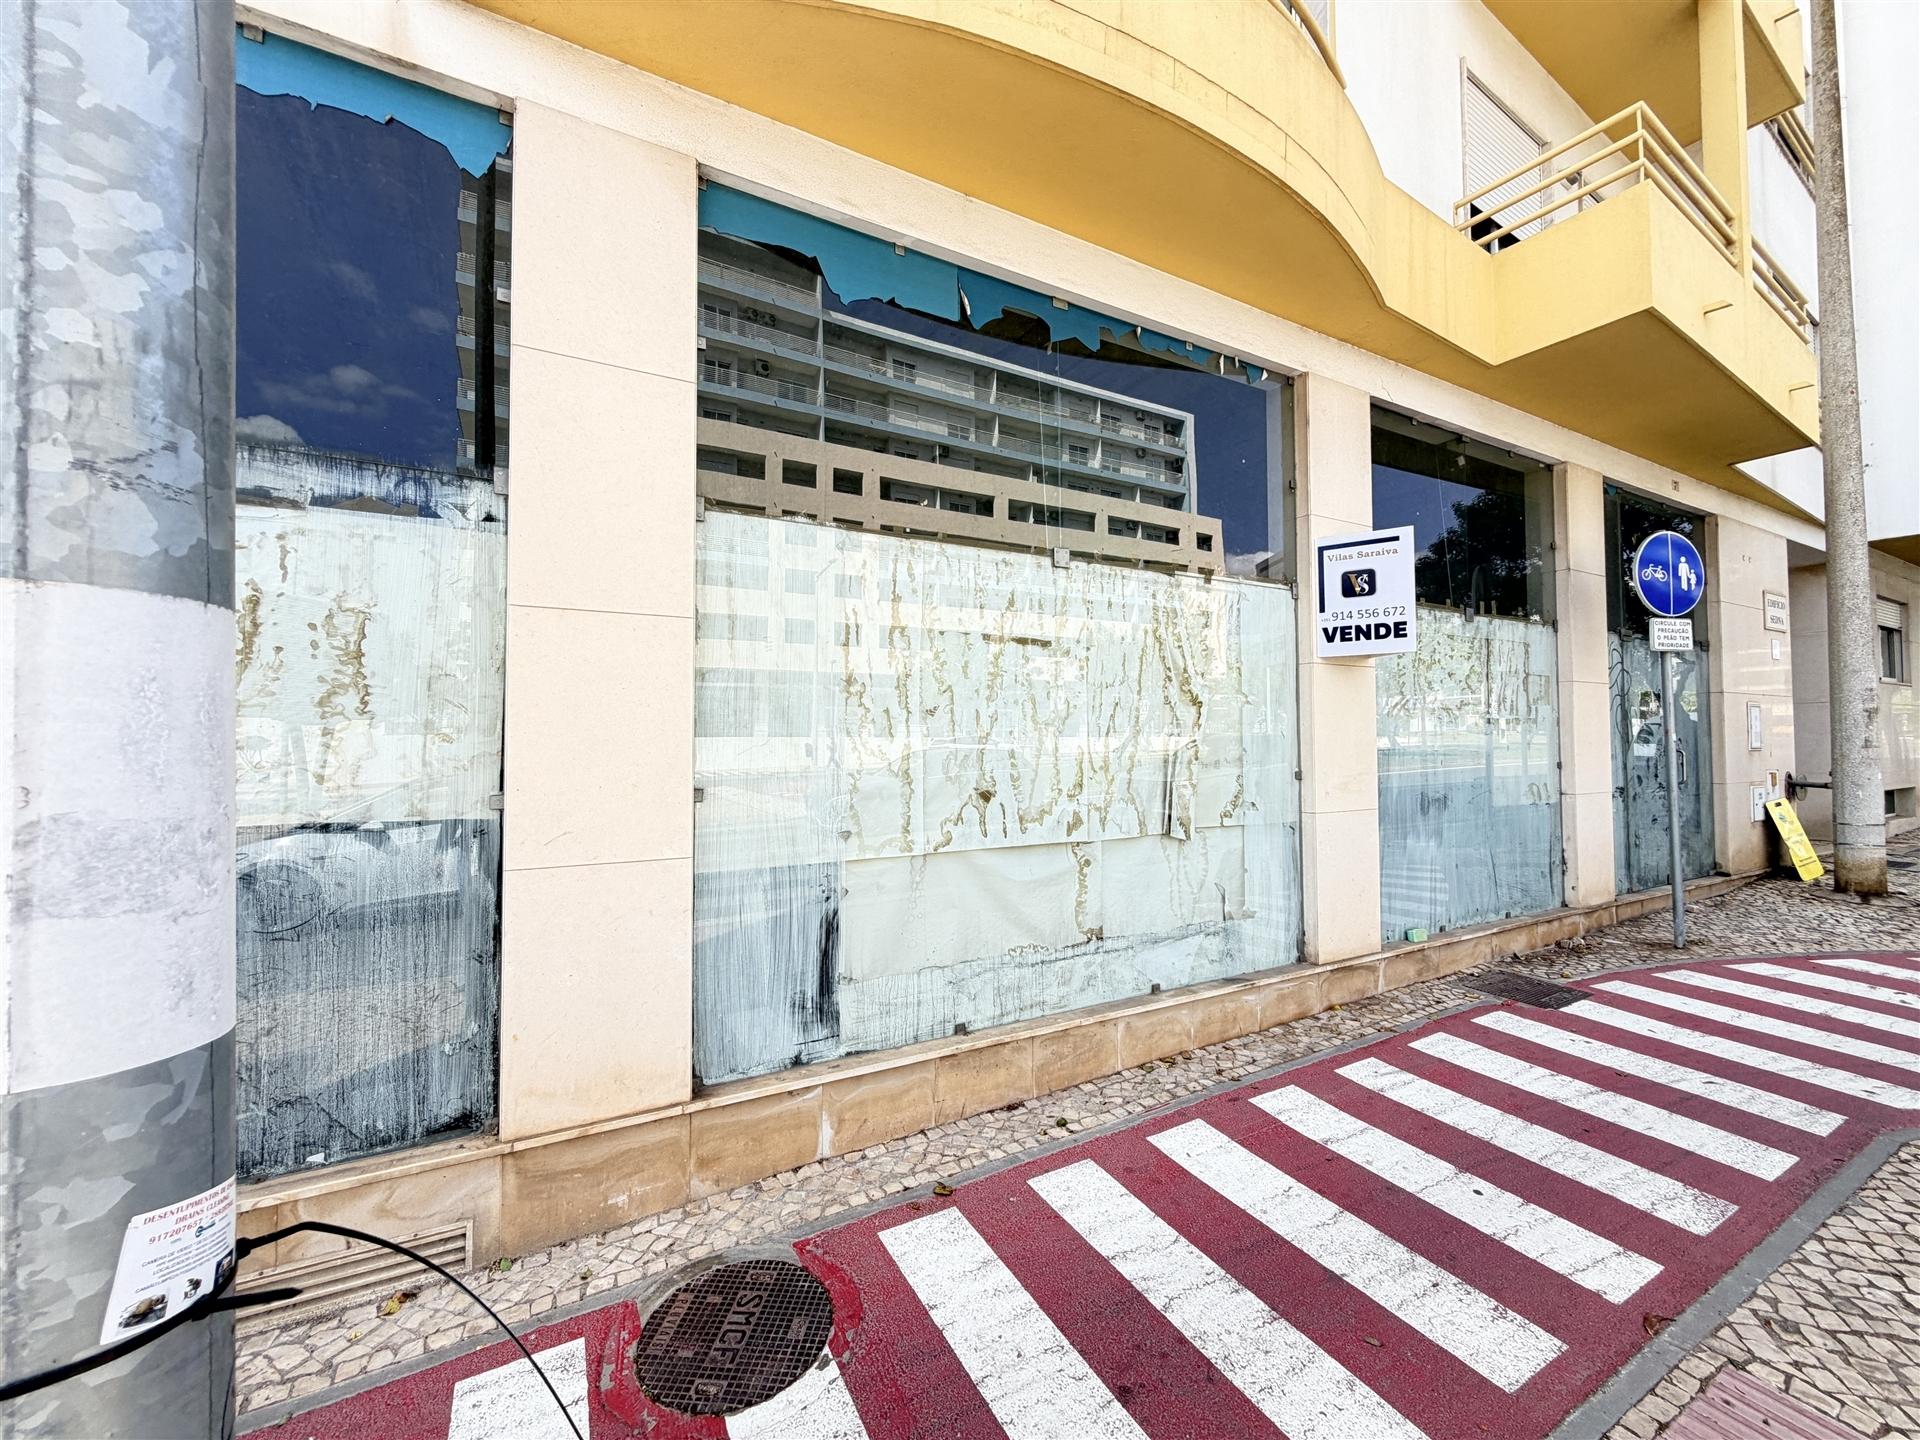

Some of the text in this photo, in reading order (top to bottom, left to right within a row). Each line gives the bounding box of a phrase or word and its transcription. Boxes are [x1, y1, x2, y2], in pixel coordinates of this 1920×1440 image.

[1327, 547, 1399, 563] Vilas Saraiva
[1347, 573, 1370, 595] VS
[1331, 610, 1353, 622] 914
[1357, 608, 1380, 619] 556
[1383, 605, 1406, 617] 672
[1322, 620, 1408, 643] VENDE
[174, 1208, 205, 1225] DRAINS
[148, 1218, 203, 1245] 917207657
[711, 1293, 764, 1364] SMCF
